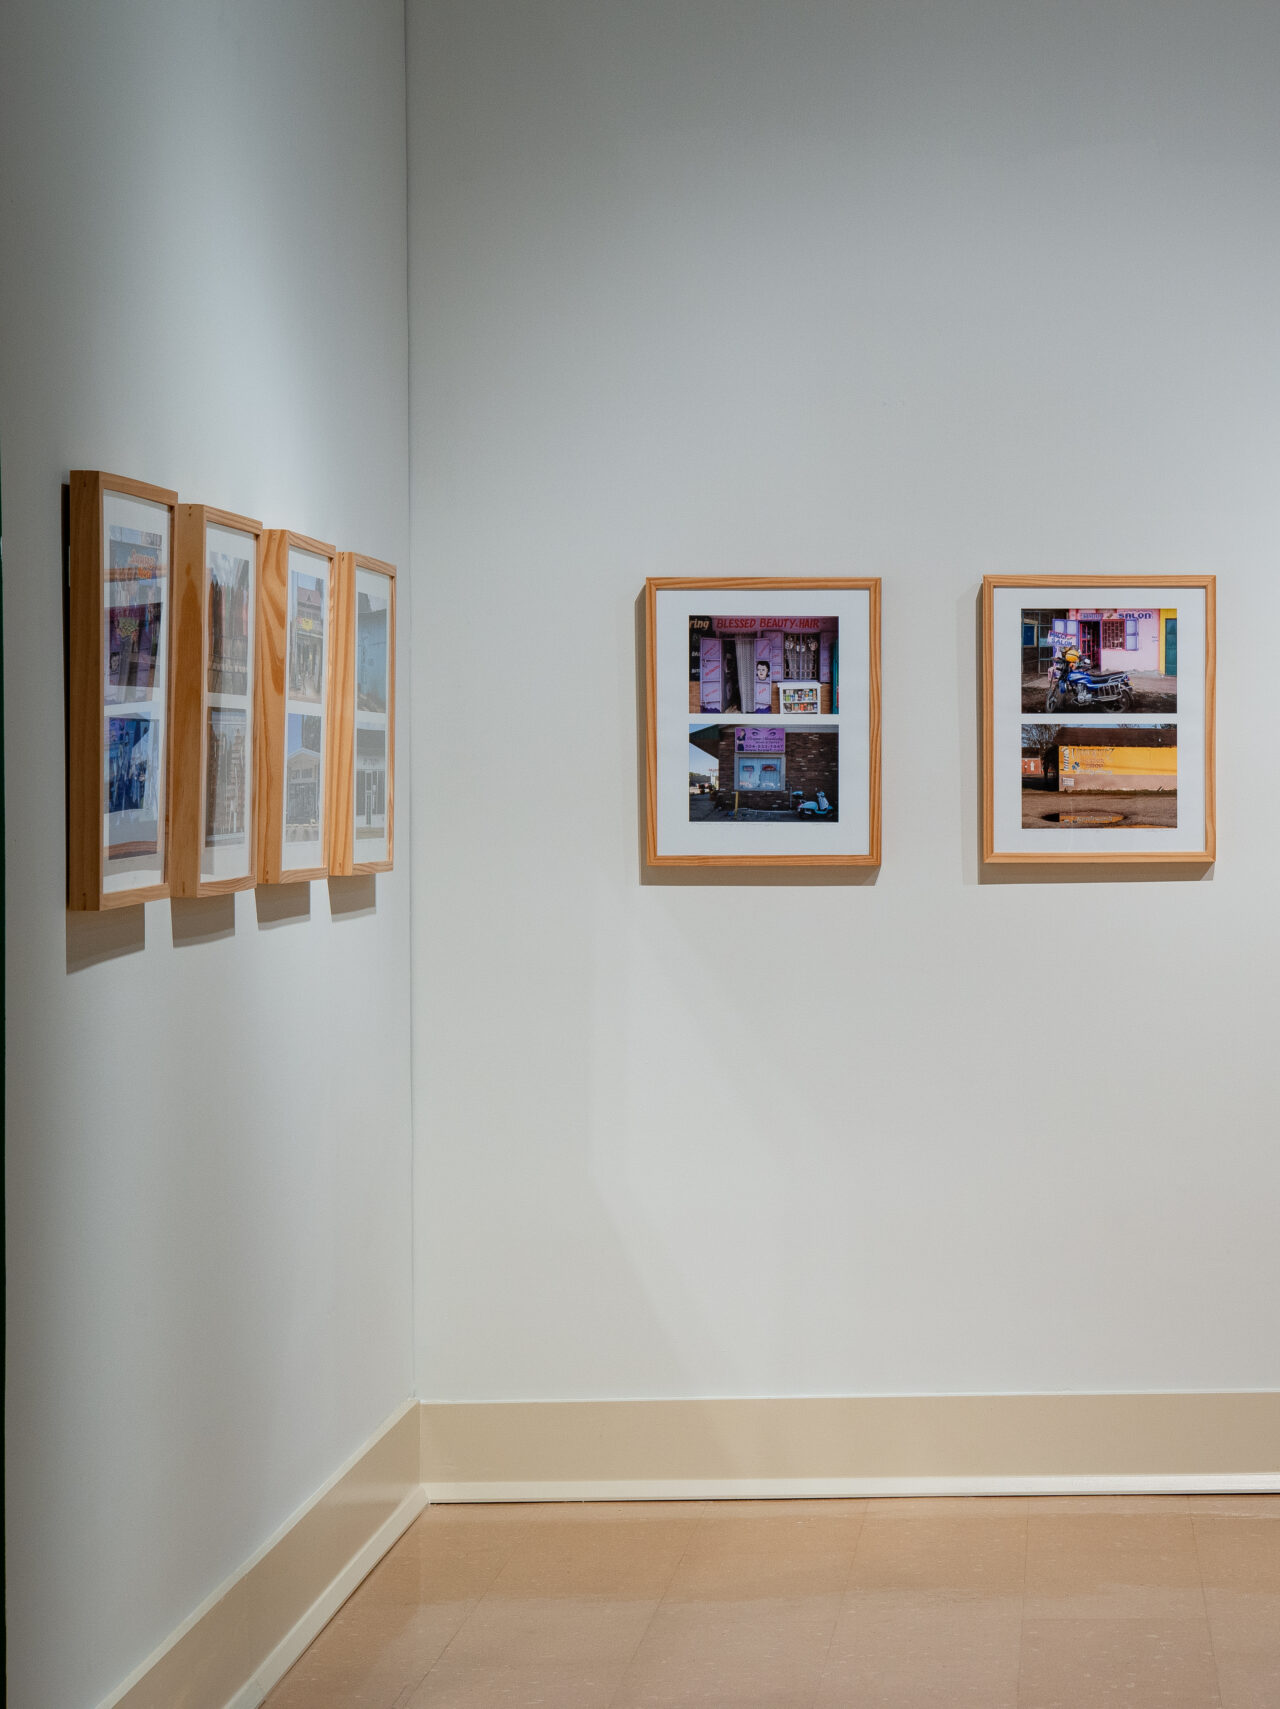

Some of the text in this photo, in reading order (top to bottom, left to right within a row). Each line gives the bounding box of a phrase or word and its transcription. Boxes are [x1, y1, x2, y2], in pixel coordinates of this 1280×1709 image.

[716, 618, 756, 629] BLESSED
[759, 618, 796, 629] BEAUTY
[799, 618, 820, 628] HAIR
